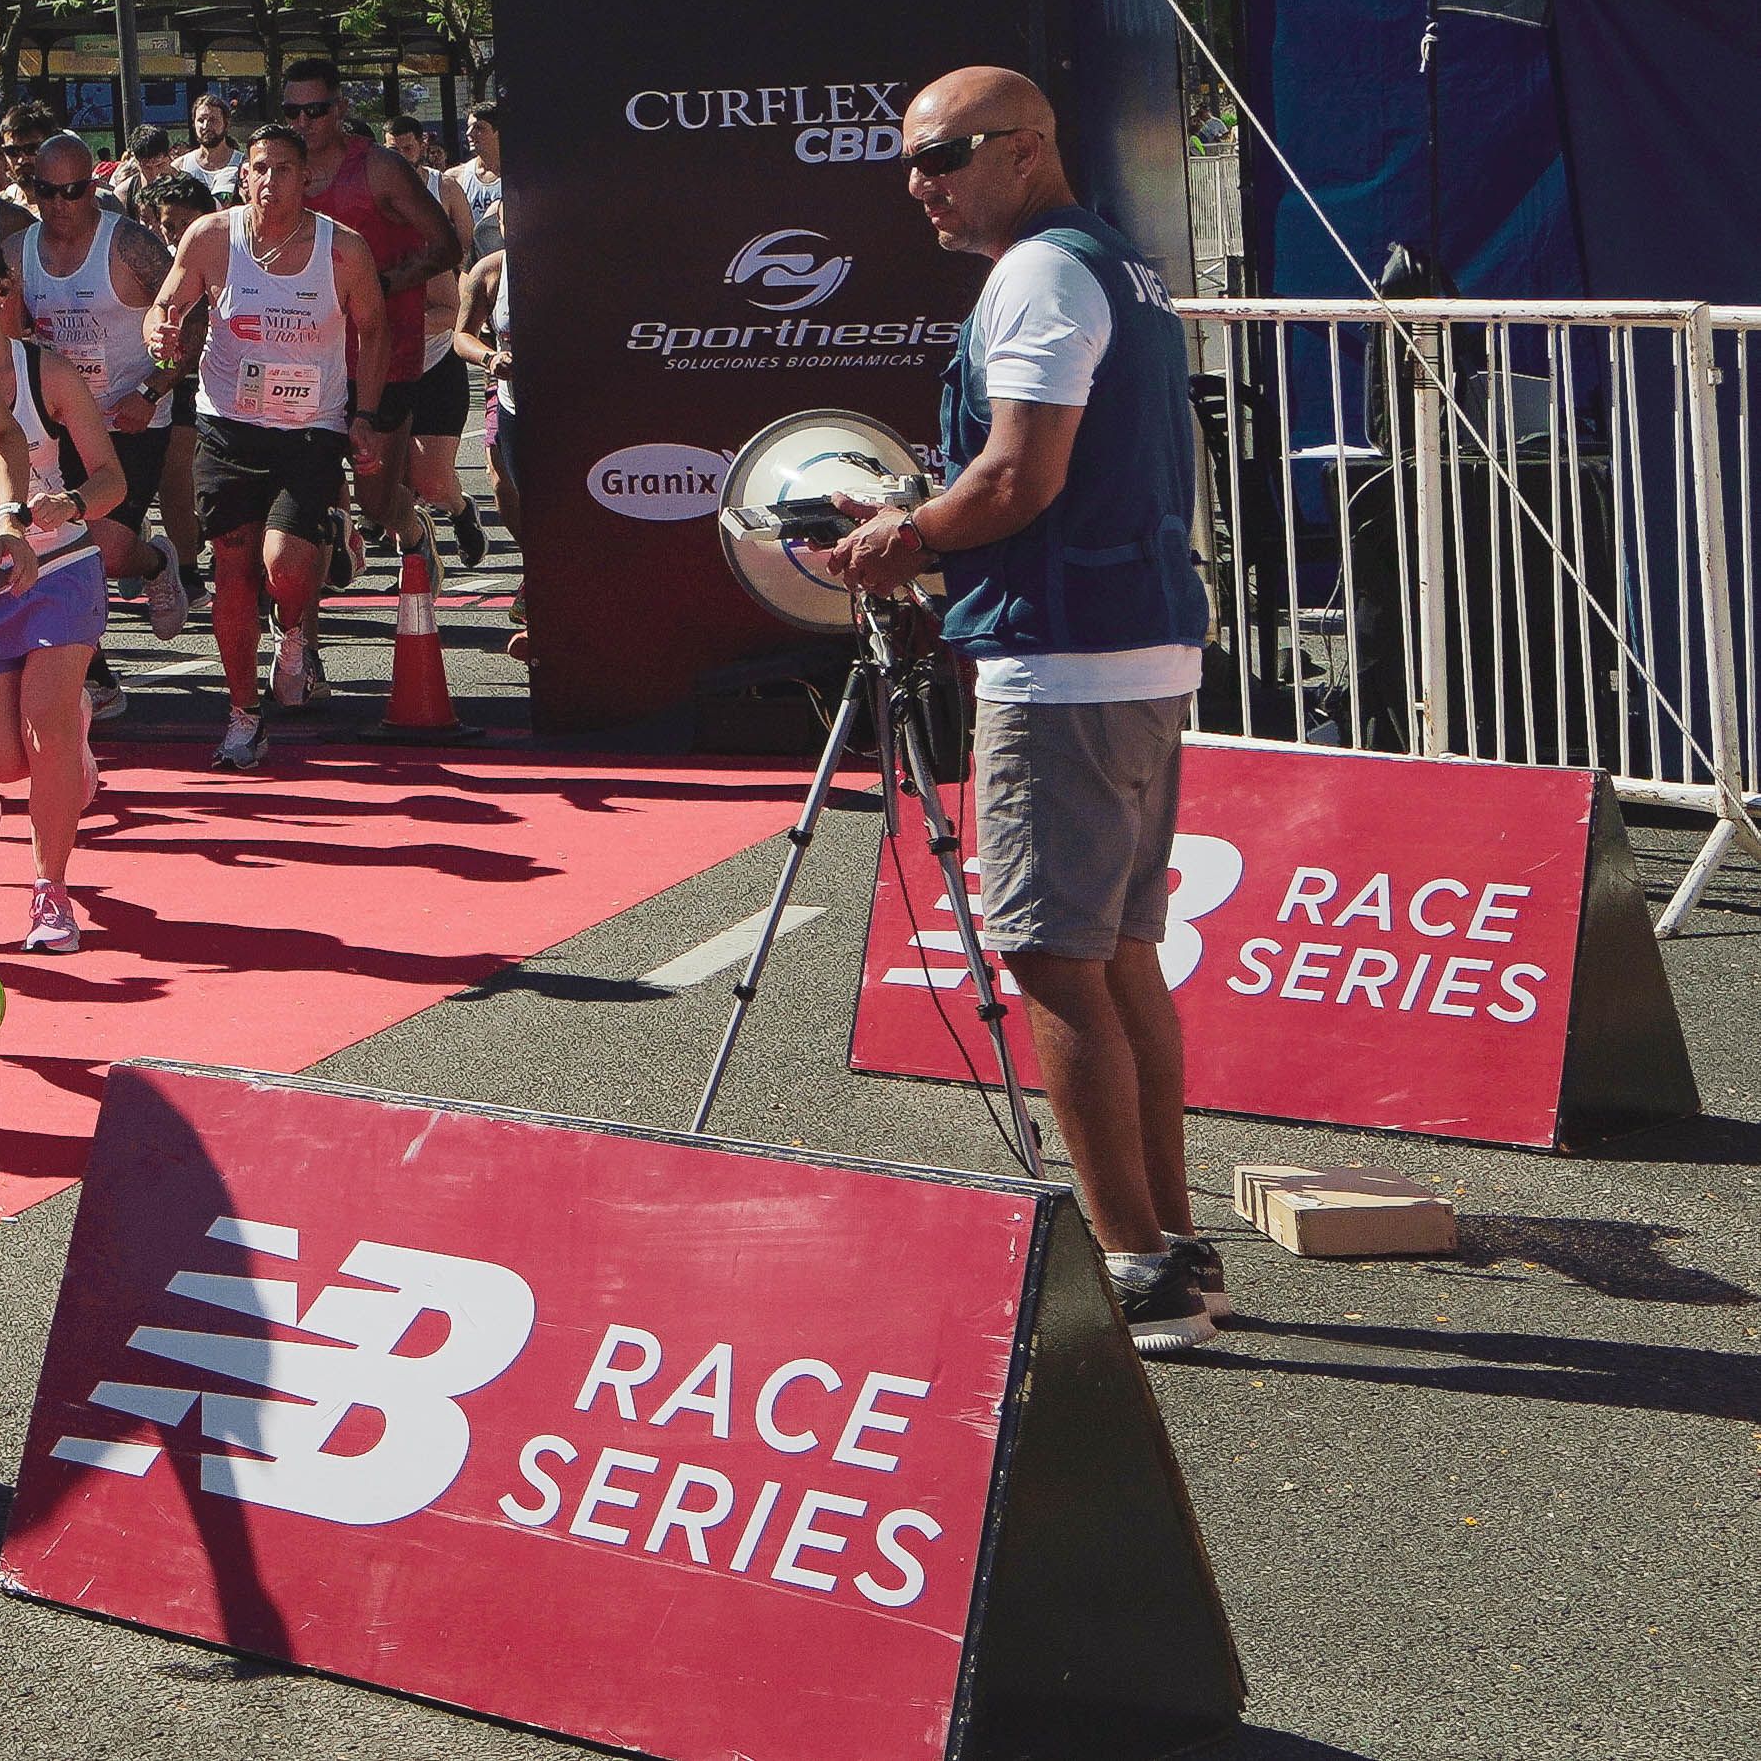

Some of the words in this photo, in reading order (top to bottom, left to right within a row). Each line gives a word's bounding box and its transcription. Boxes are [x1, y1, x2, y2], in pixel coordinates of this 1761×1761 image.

[624, 80, 906, 131] CURFLEX
[794, 125, 904, 163] CBD
[55, 315, 101, 329] MILLA
[265, 315, 318, 331] MILLA
[626, 315, 962, 356] Sporthesis
[76, 364, 102, 376] 046
[246, 364, 260, 378] D
[663, 355, 780, 371] SOLUCIONES
[785, 352, 926, 368] BIODINAMICAS
[271, 385, 311, 398] D1113
[600, 465, 718, 496] Granix
[1276, 864, 1533, 944] RACE
[1226, 936, 1549, 1025] SERIES
[573, 1322, 933, 1476] RACE
[496, 1433, 945, 1610] SERIES
